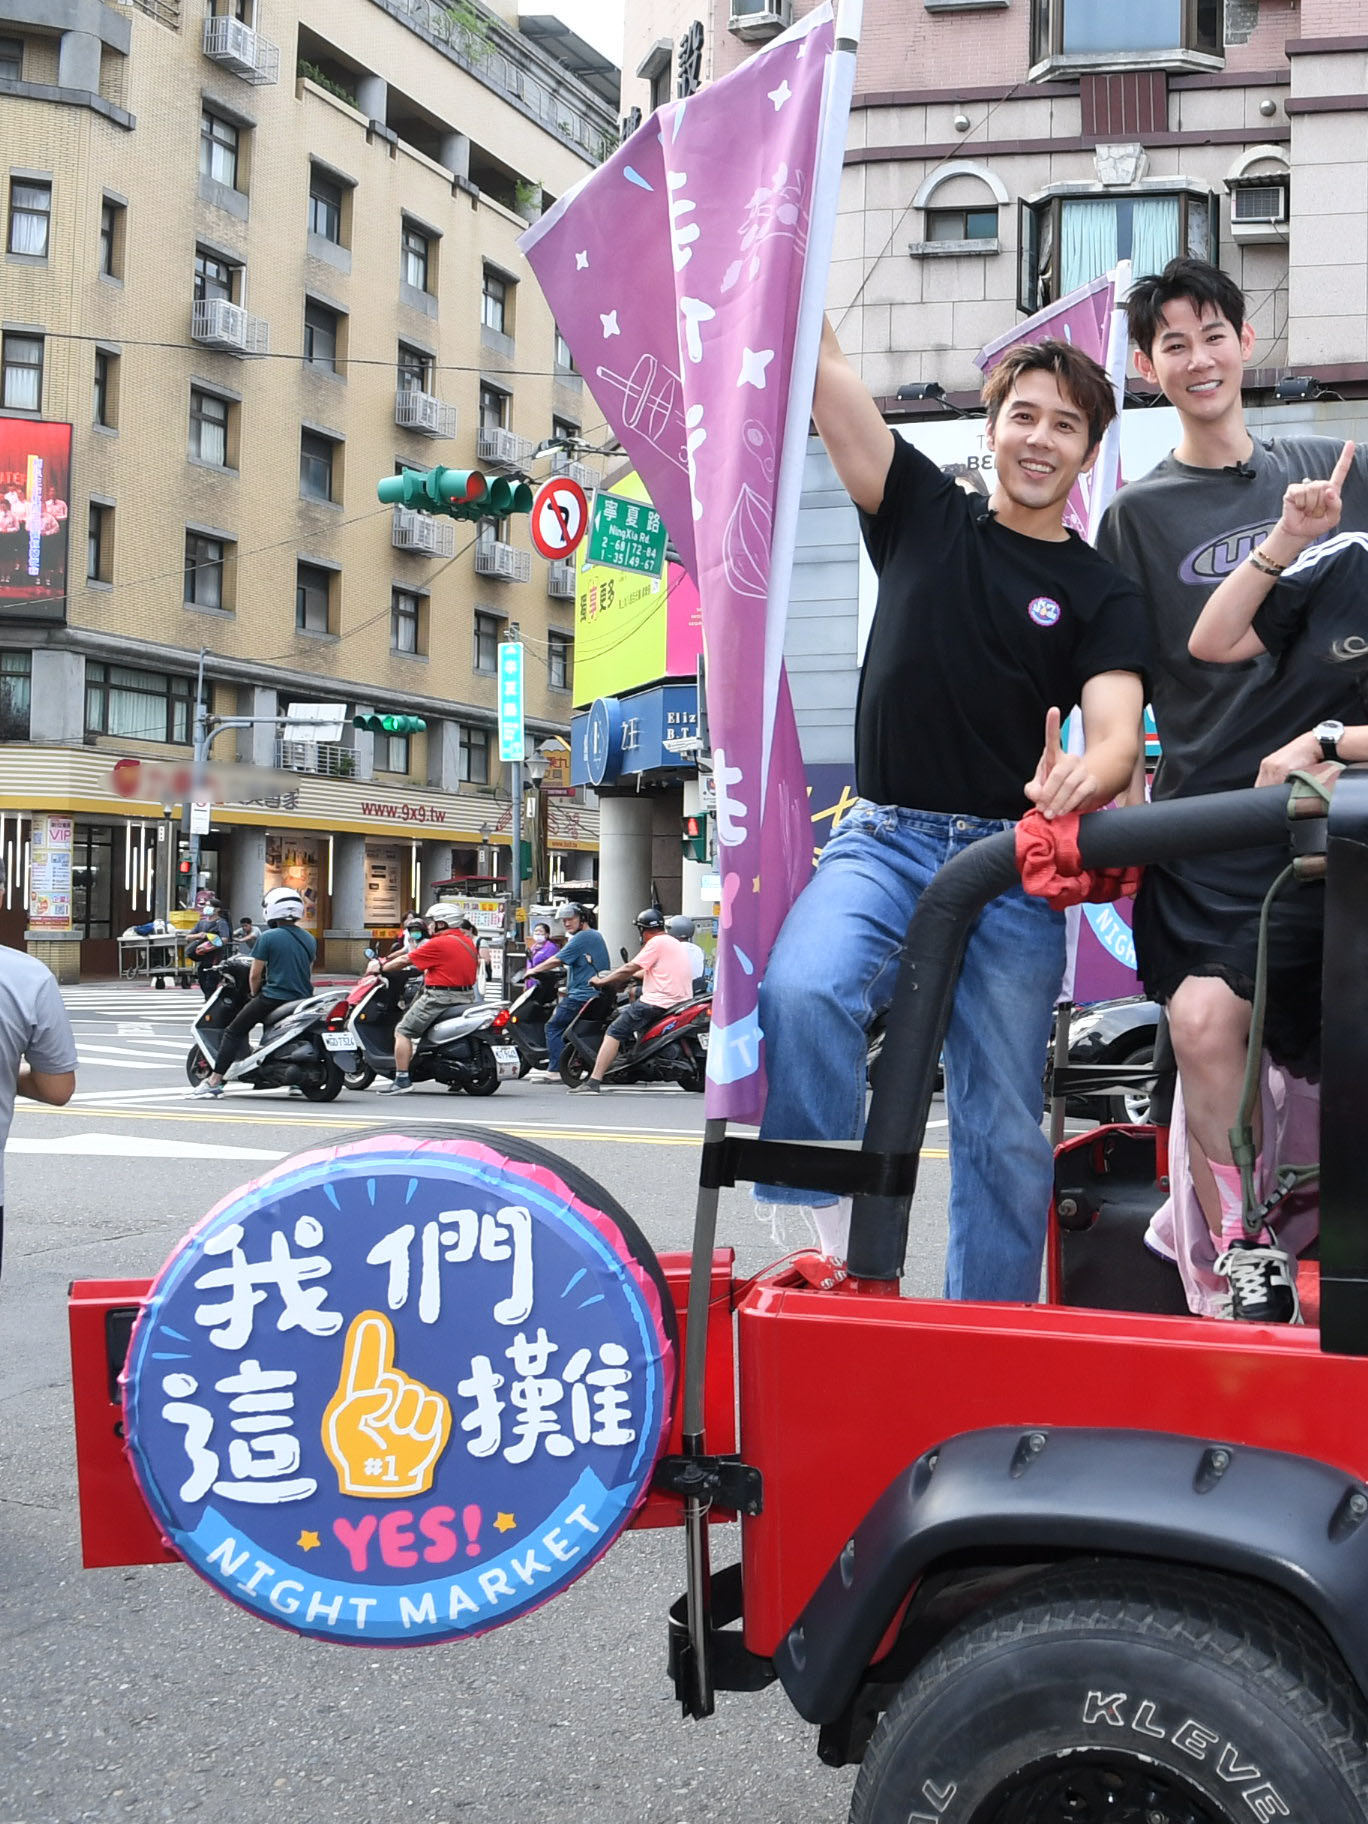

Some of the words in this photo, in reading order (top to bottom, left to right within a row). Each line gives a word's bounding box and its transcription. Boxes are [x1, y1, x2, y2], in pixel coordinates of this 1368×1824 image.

[603, 499, 661, 533] 寧夏路
[361, 801, 447, 823] www.9x9.tw
[49, 829, 71, 841] VIP
[1096, 908, 1137, 964] NIGH
[194, 1206, 534, 1350] 我們
[363, 1454, 399, 1481] #1
[333, 1504, 484, 1572] YES!
[205, 1536, 378, 1630] NIGHT
[398, 1503, 602, 1630] MARKET
